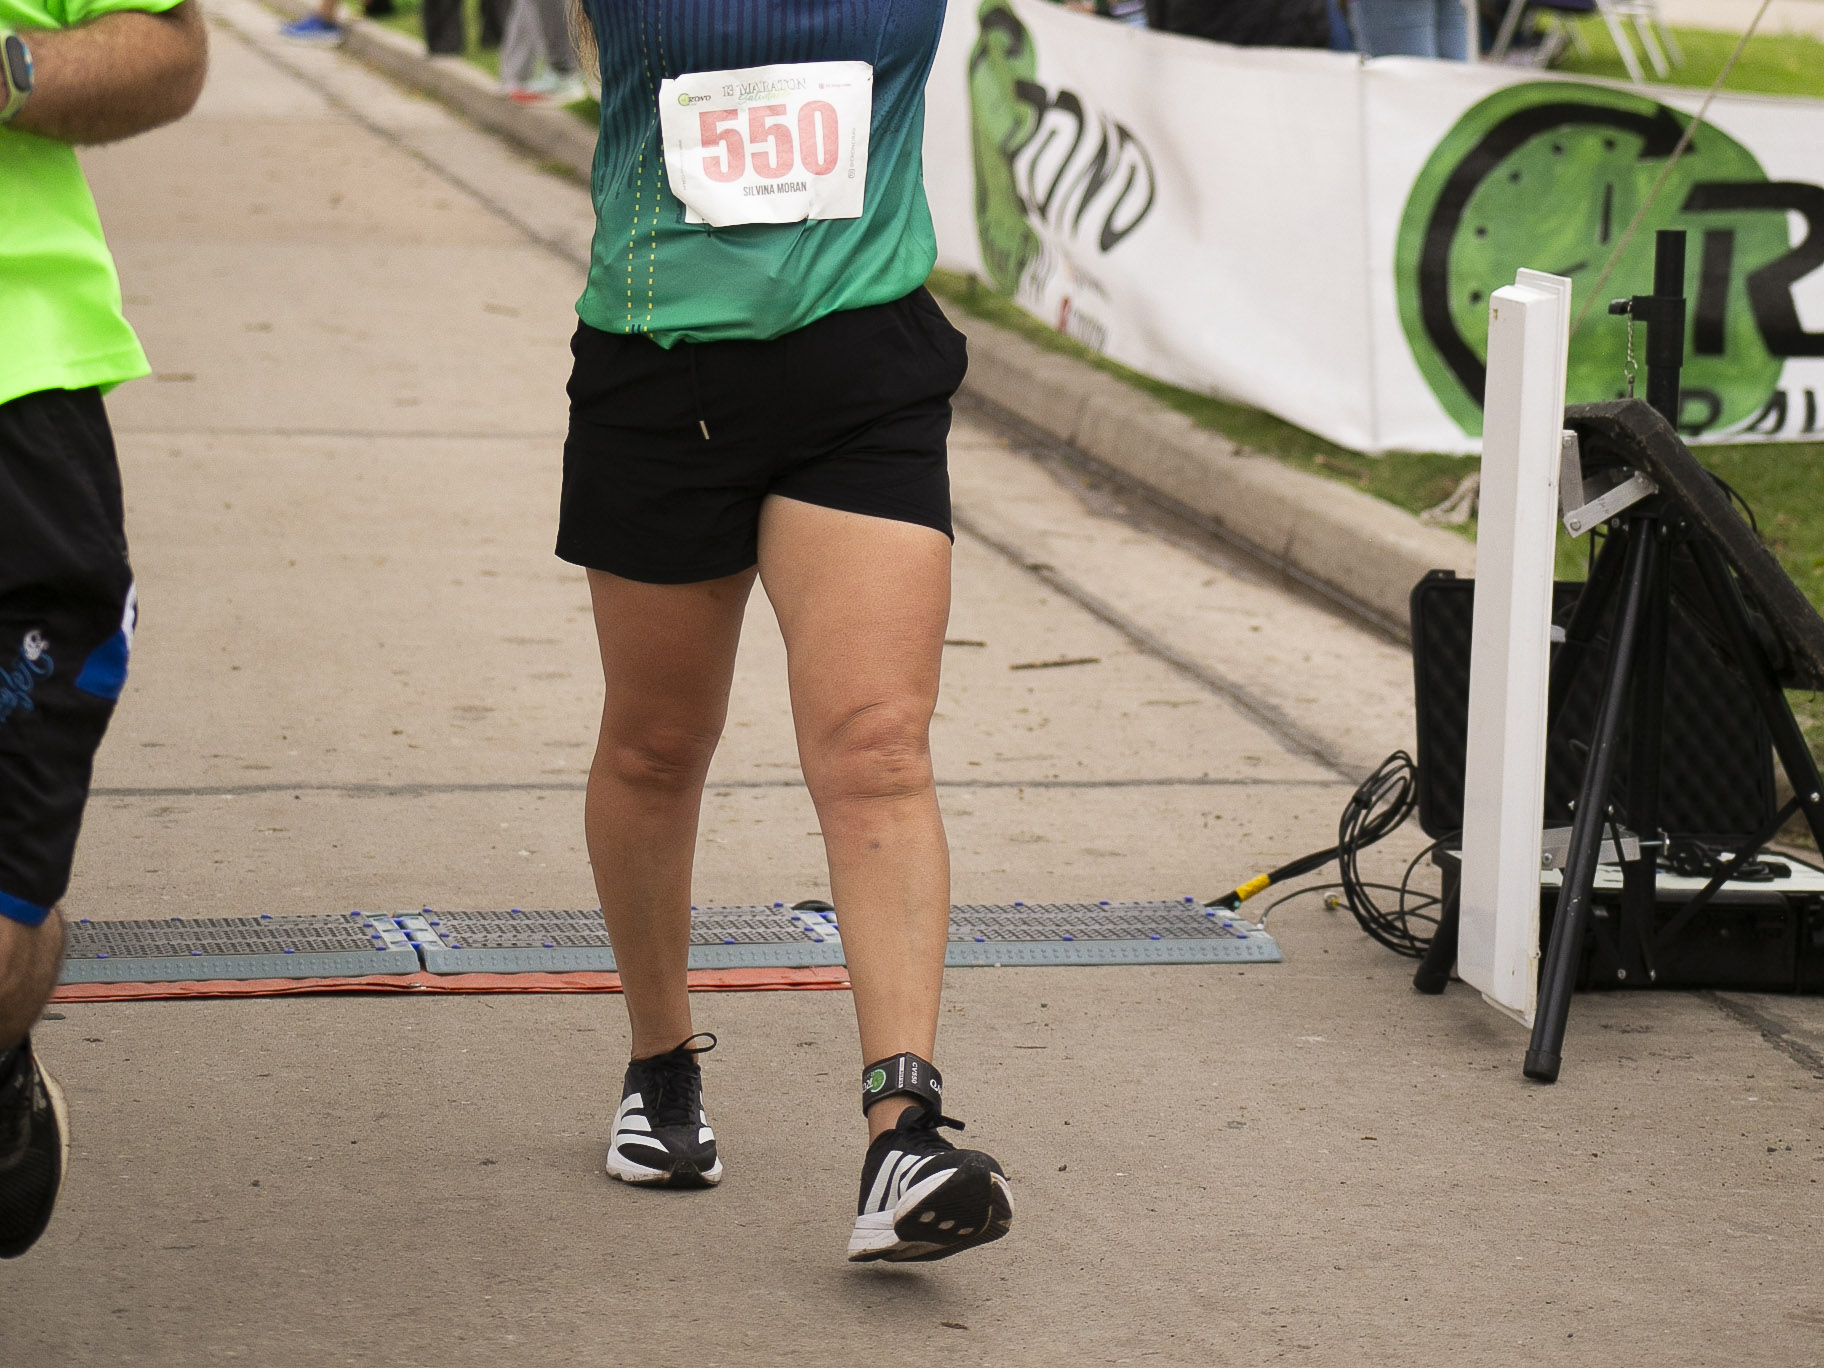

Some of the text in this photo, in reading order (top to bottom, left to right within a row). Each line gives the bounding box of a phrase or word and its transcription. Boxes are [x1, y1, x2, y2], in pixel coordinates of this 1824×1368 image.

[698, 99, 839, 183] 550
[743, 181, 807, 196] SILVINA MORAN
